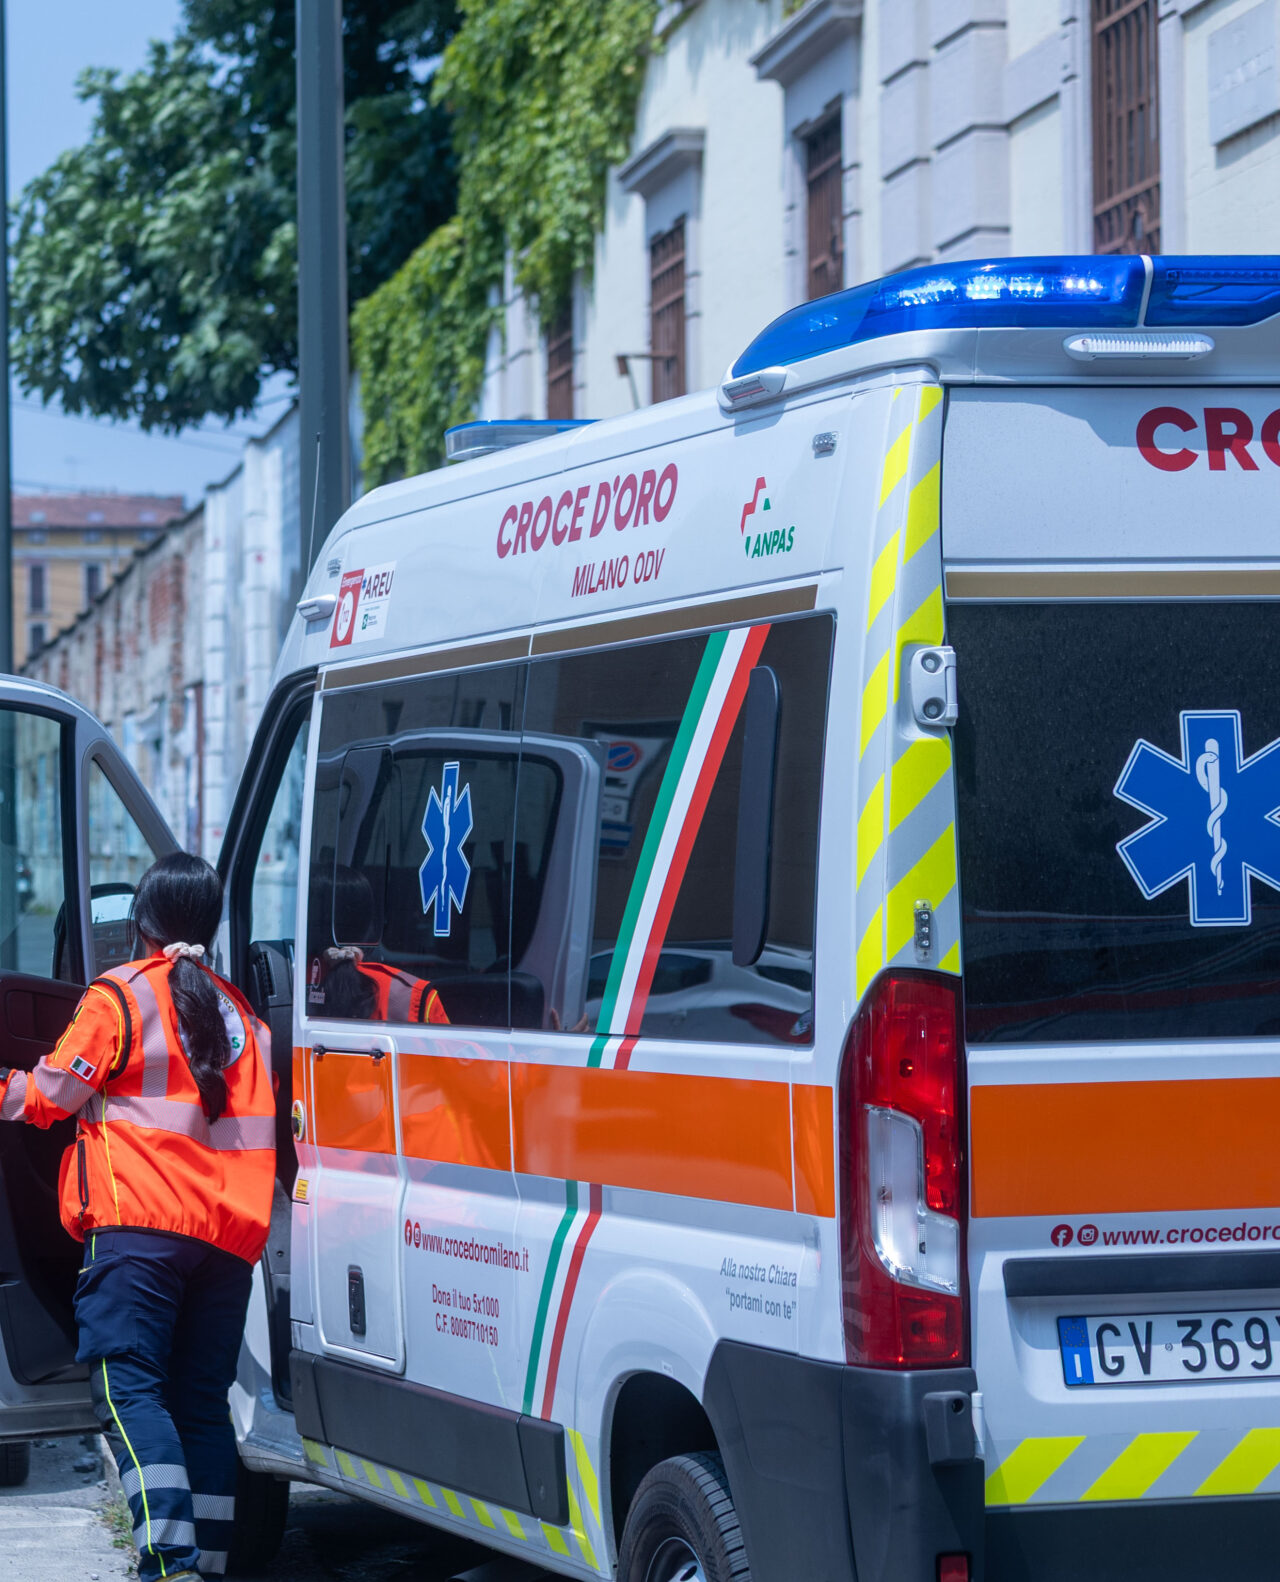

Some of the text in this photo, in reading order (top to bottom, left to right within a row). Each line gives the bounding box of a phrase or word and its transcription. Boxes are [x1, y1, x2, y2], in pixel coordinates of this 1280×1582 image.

[1136, 406, 1280, 472] CR
[496, 462, 678, 559] CROCE D'ORO
[751, 525, 795, 559] ANPAS
[363, 570, 394, 600] AREU
[571, 547, 666, 598] MILANO ODV
[422, 1232, 529, 1272] www.crocedoromilano.it
[720, 1257, 797, 1287] Alla nostra Chiara
[432, 1284, 499, 1318] Dona il tuo 5x1000
[726, 1287, 797, 1320] “portami con te”
[435, 1312, 498, 1346] C.F. 80087710150
[1096, 1321, 1153, 1376] GV
[1177, 1316, 1280, 1373] 369
